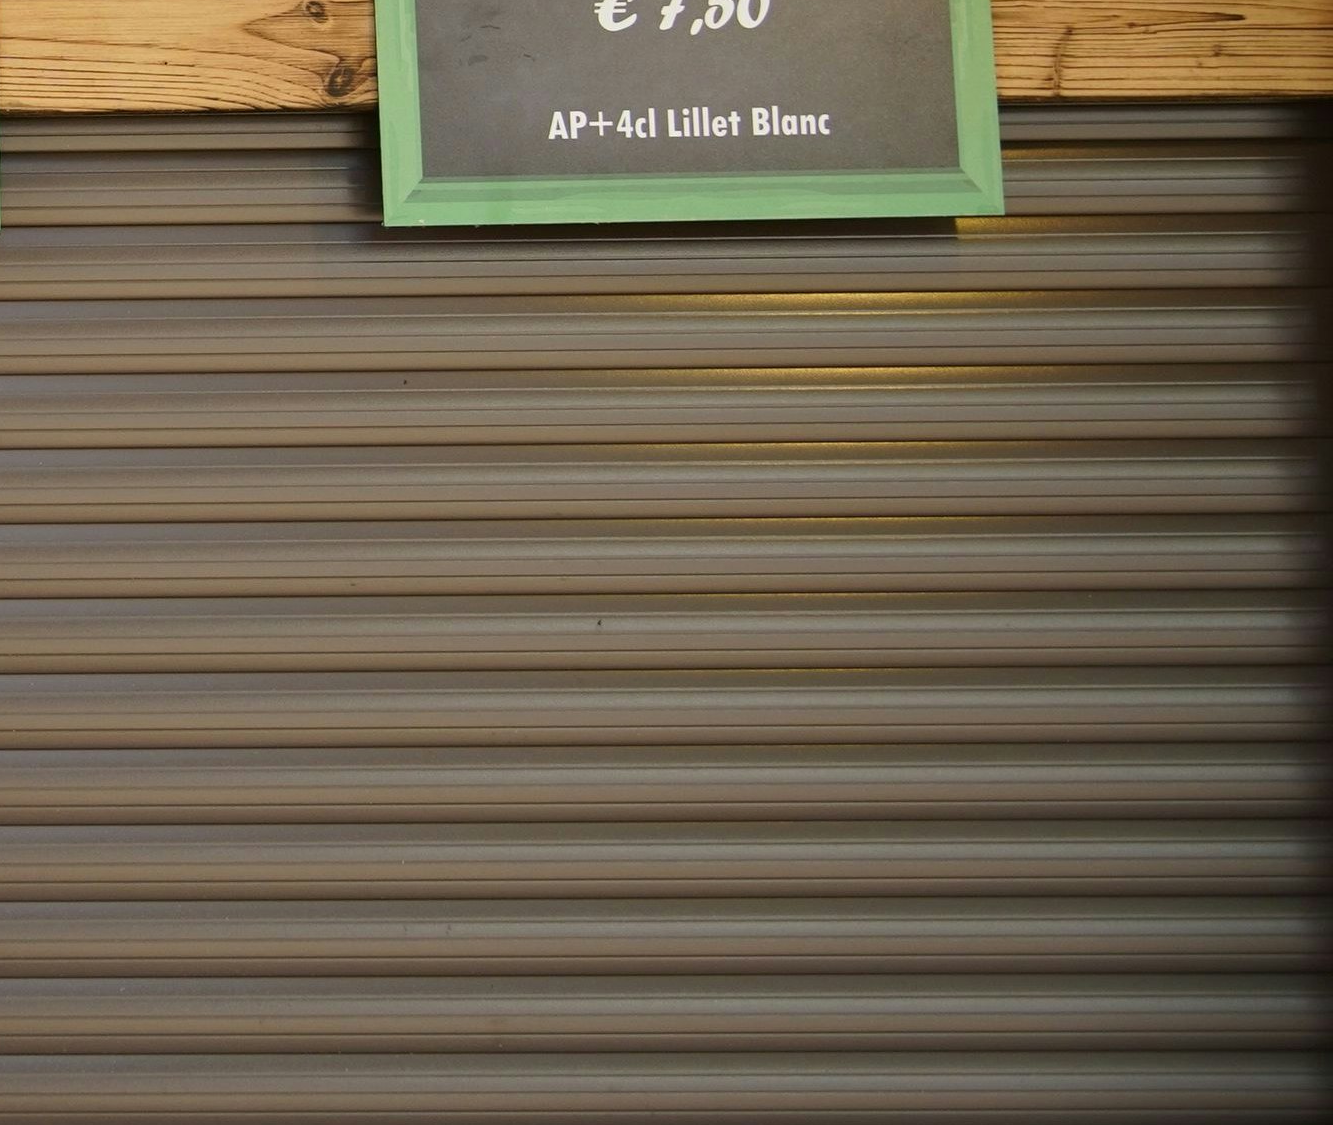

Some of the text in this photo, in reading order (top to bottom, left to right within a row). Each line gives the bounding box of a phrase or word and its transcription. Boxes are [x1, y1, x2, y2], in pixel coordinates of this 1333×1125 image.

[548, 105, 831, 140] AP+4cl Lillet Blanc
